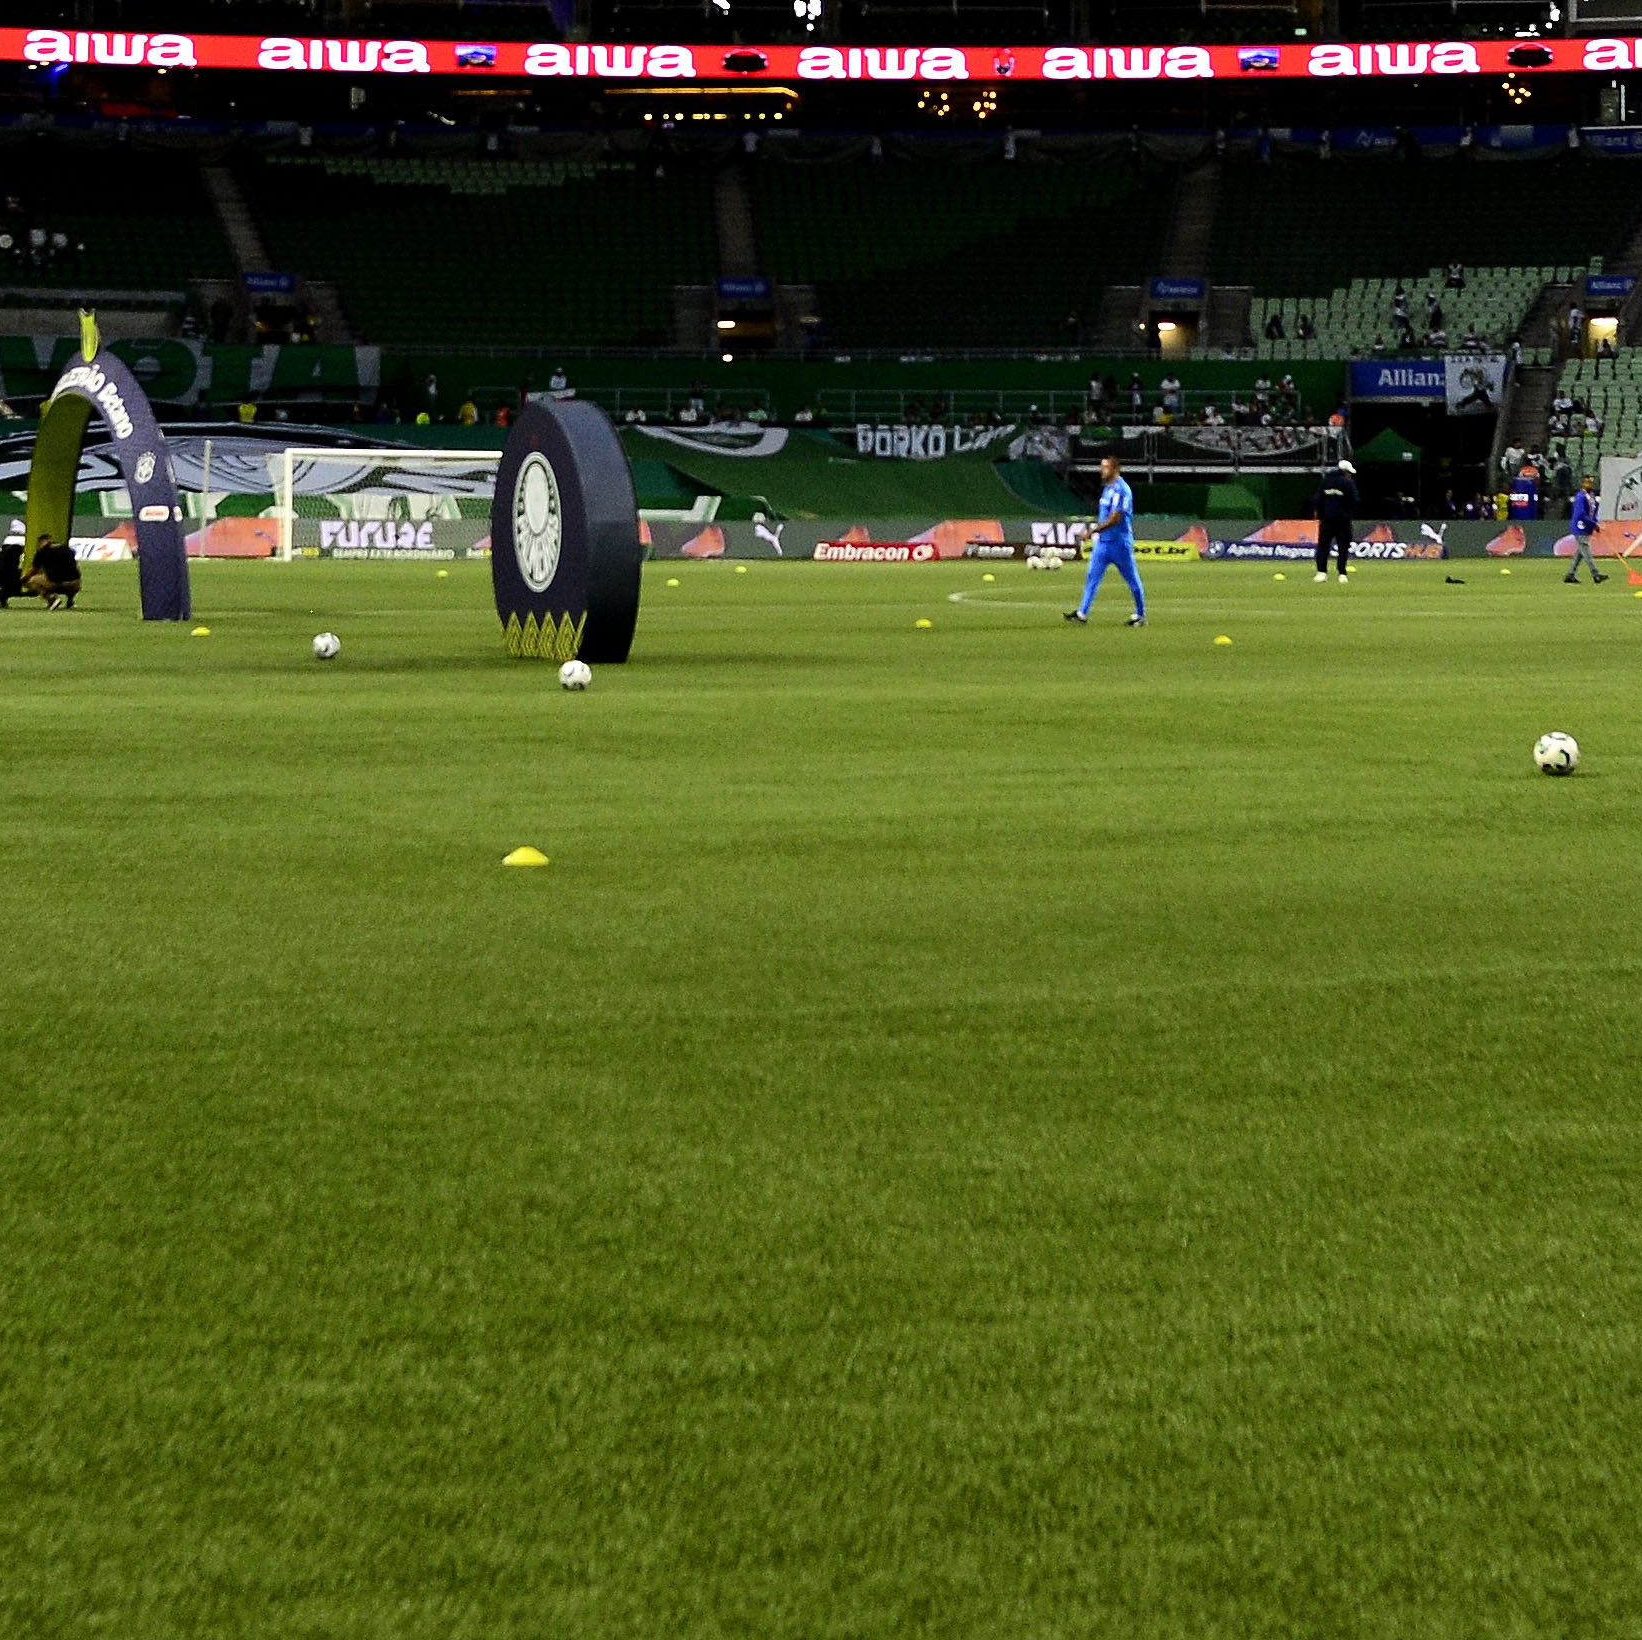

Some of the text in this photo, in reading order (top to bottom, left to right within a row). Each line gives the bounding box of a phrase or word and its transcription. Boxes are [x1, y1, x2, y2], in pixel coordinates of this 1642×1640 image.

[24, 30, 196, 67] aiwa
[259, 37, 430, 74] aiwa
[524, 44, 696, 79] aiwa
[798, 46, 969, 80] aiwa
[1043, 46, 1214, 80] aiwa
[1309, 42, 1480, 76] aiwa
[1378, 368, 1446, 387] Allian
[857, 423, 947, 460] PORKO
[320, 520, 436, 550] FUTURE
[813, 543, 910, 562] Embracon
